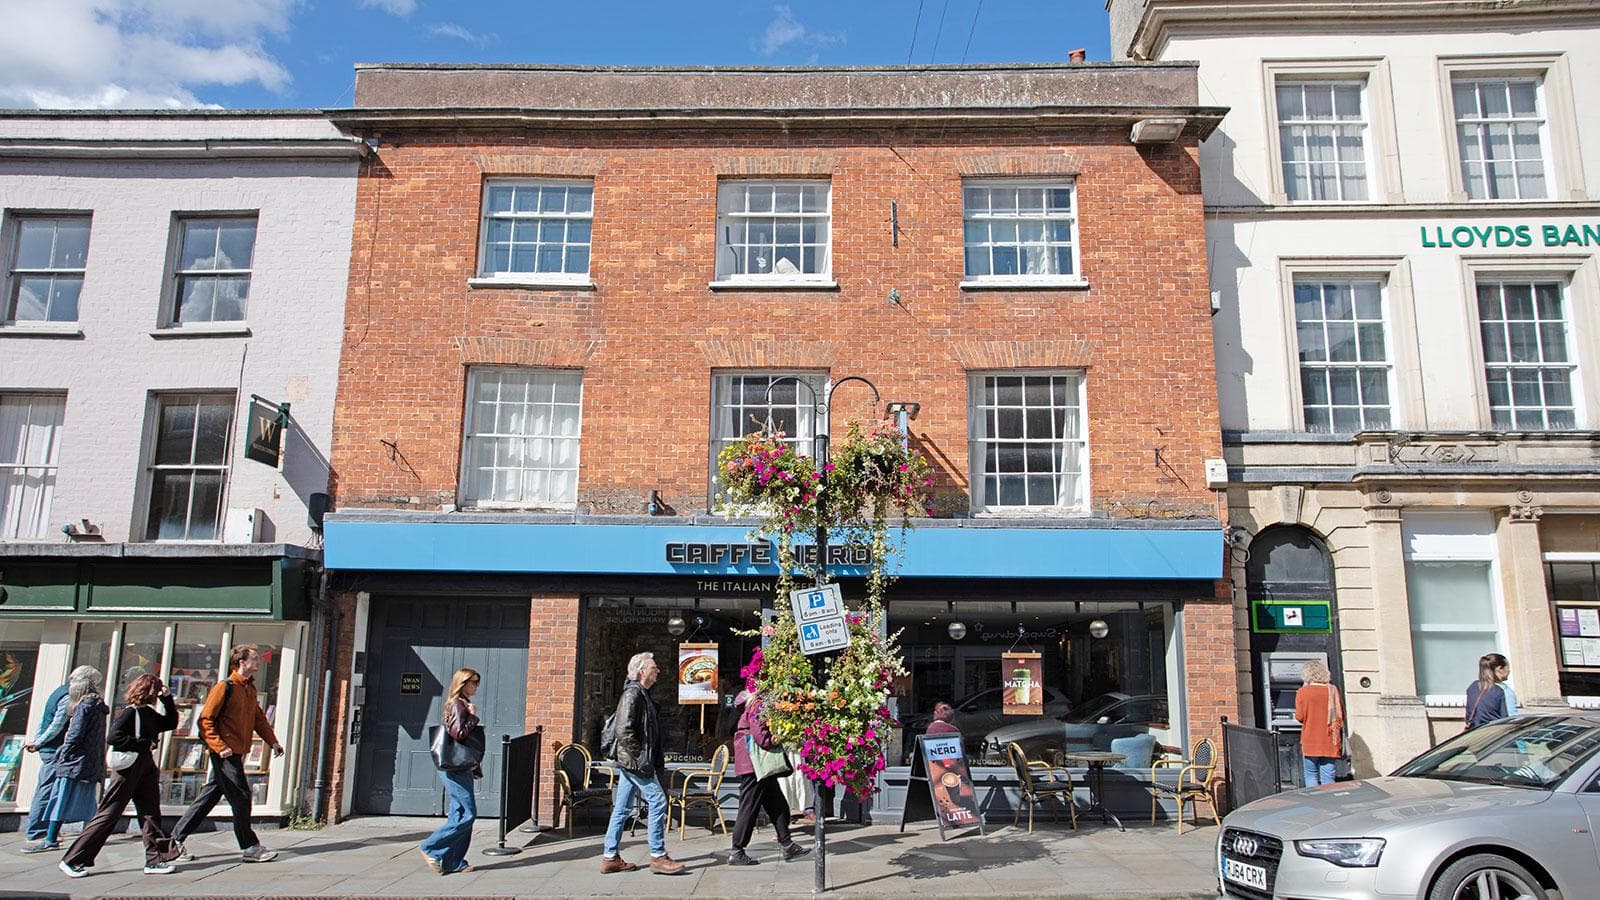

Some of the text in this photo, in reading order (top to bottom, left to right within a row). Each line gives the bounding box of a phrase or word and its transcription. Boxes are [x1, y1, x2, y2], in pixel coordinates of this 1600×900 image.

[1421, 225, 1533, 247] LLOYDS
[258, 416, 277, 443] W
[697, 581, 719, 591] THE
[722, 581, 771, 592] ITALIAN
[931, 746, 957, 756] NERO
[946, 809, 973, 822] LATTE
[1246, 866, 1264, 886] CRX
